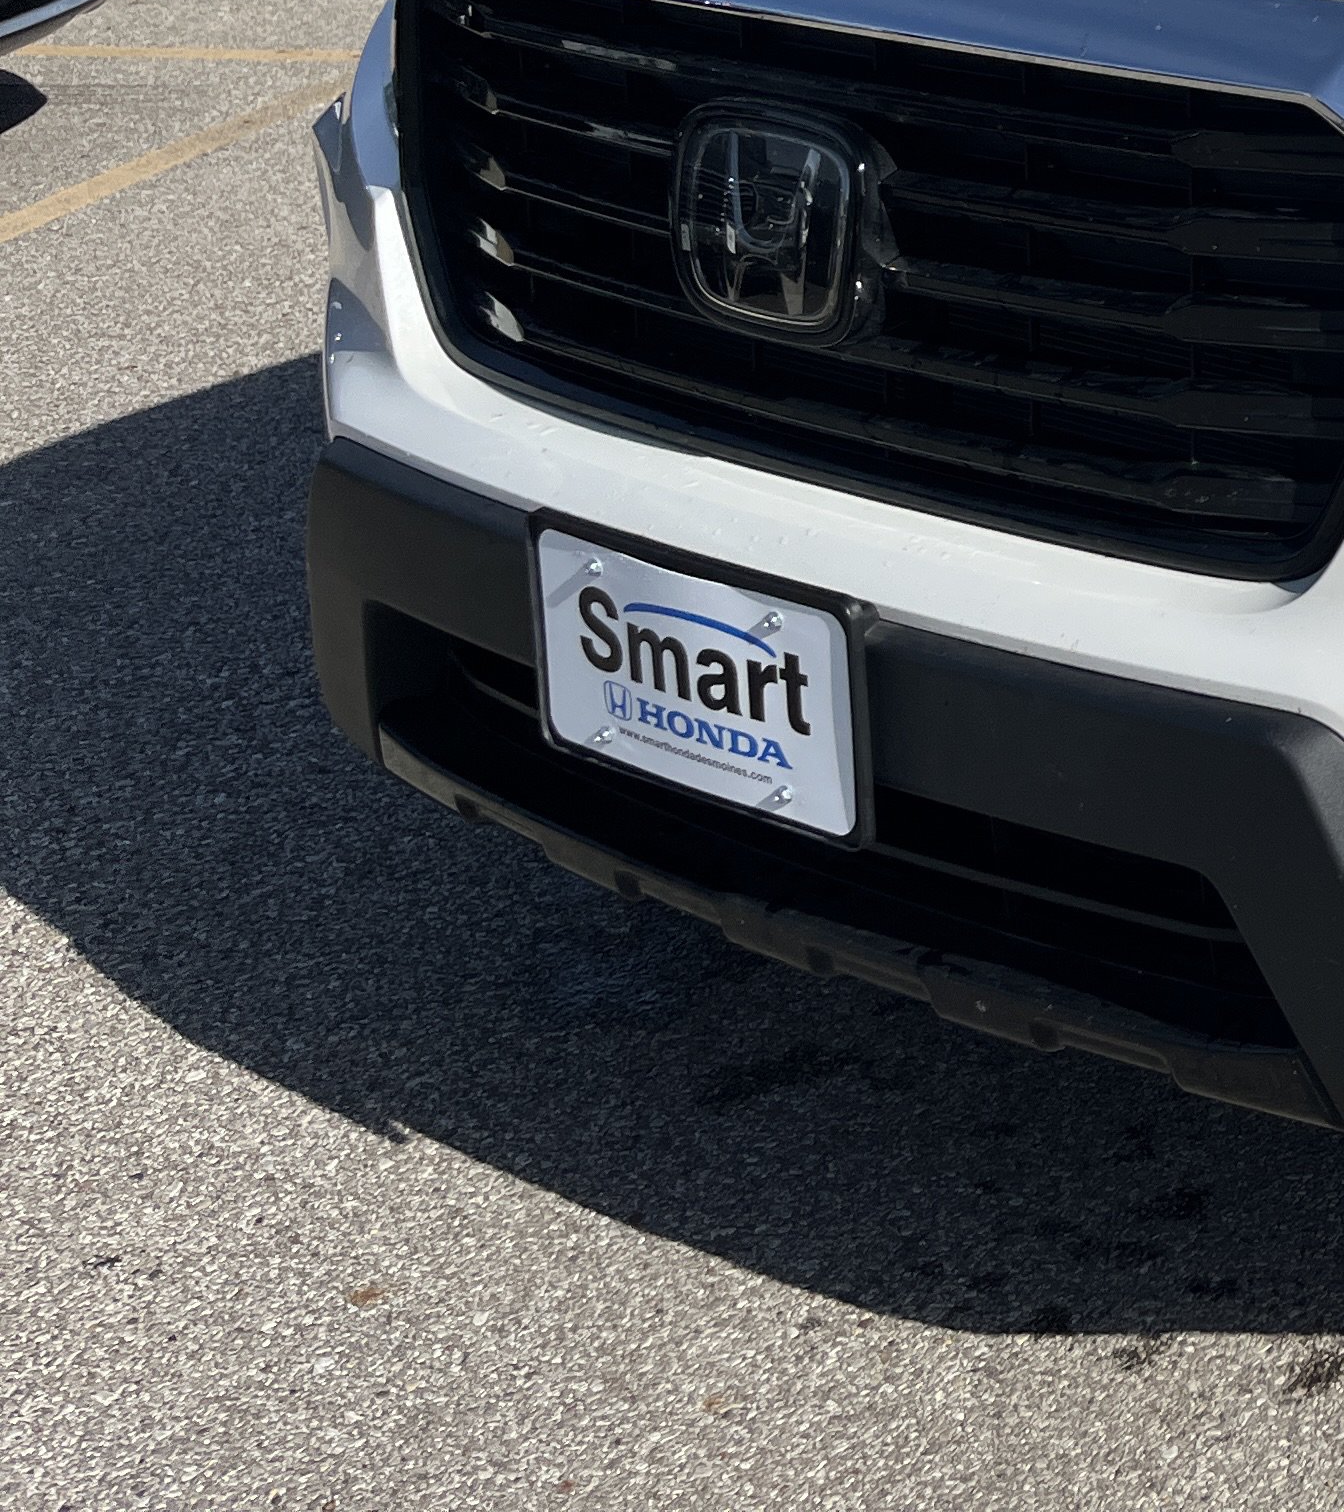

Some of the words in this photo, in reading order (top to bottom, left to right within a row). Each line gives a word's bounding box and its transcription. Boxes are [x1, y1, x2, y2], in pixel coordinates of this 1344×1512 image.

[578, 586, 812, 736] Smart
[618, 726, 773, 785] www.smarthondadesmoines.com
[636, 697, 793, 770] HONDA
